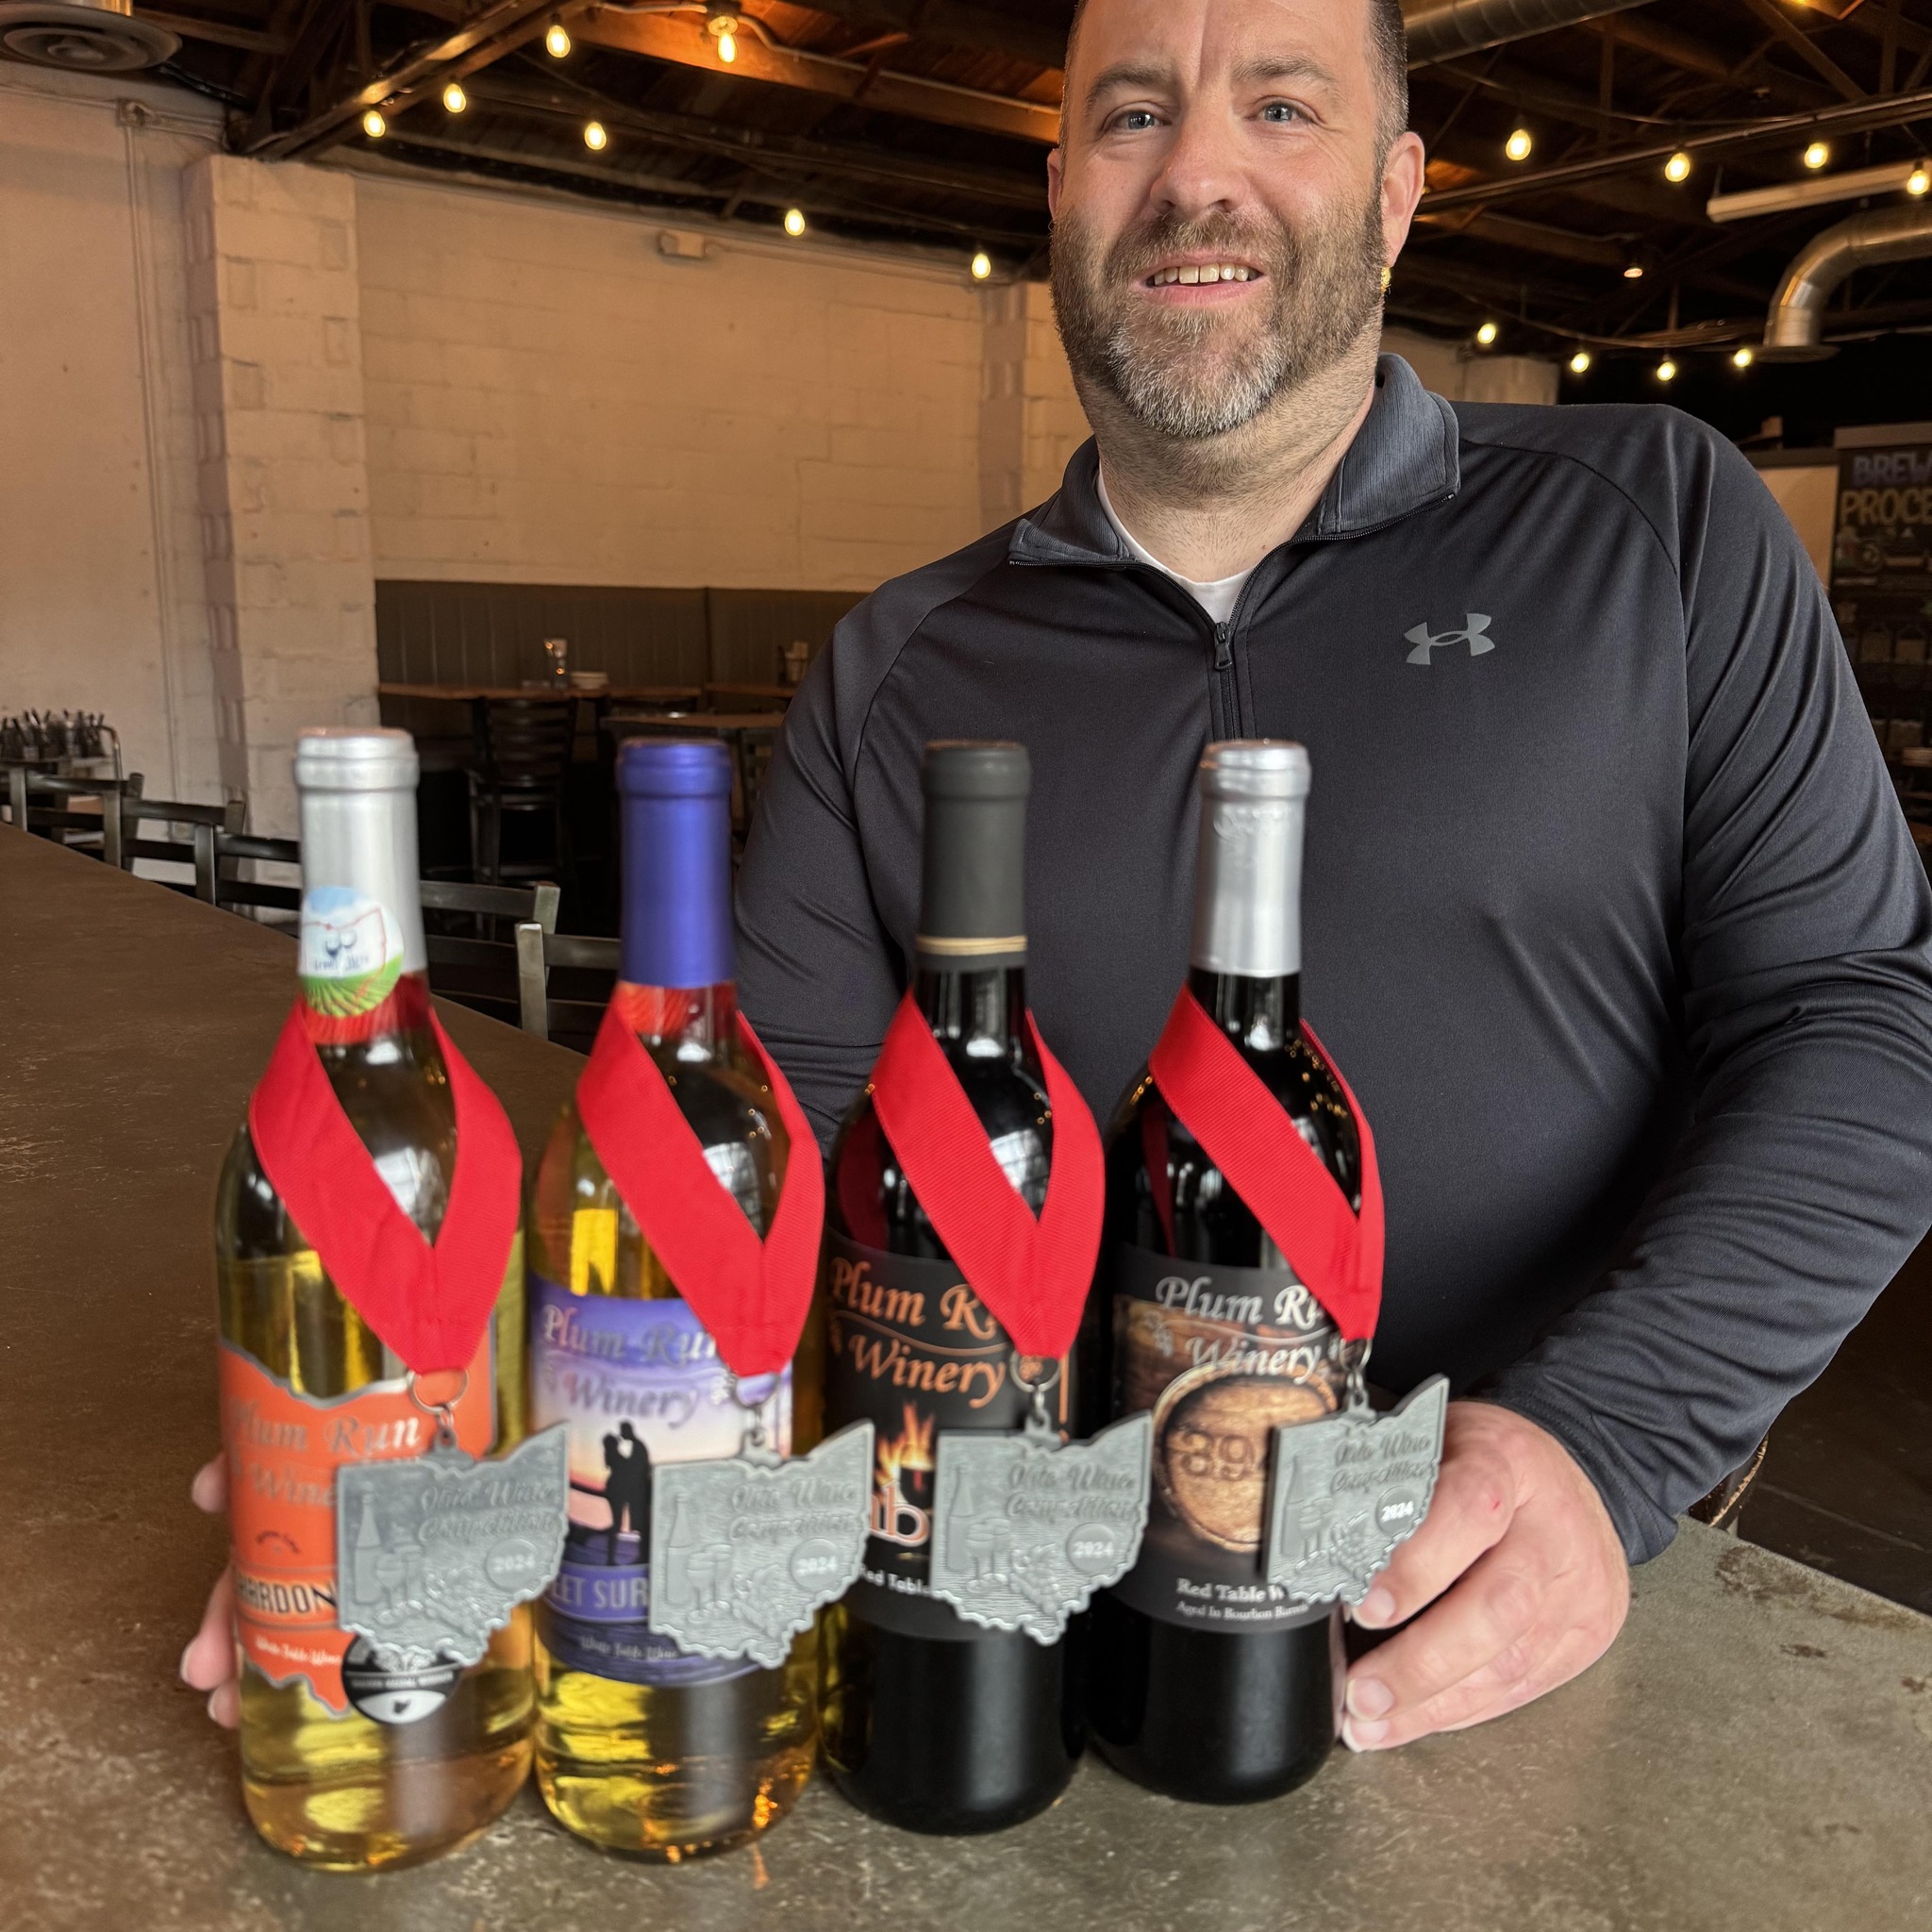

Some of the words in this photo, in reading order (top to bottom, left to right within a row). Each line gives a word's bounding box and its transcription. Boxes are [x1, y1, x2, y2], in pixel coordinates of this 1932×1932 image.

[829, 1257, 925, 1327] Plum
[1156, 1275, 1264, 1324] Plum
[541, 1304, 625, 1359] Plum
[847, 1334, 1007, 1410] Winery
[1186, 1337, 1321, 1385] Winery
[564, 1372, 701, 1429] Winery
[322, 1414, 422, 1459] Run
[1380, 1501, 1414, 1523] 2024
[492, 1555, 537, 1573] 2024
[796, 1556, 838, 1576] 2024
[1074, 1541, 1114, 1558] 2024
[1176, 1577, 1213, 1600] Red
[1215, 1583, 1267, 1603] Table
[1176, 1601, 1206, 1618] Aged
[1224, 1607, 1273, 1621] Bourbon
